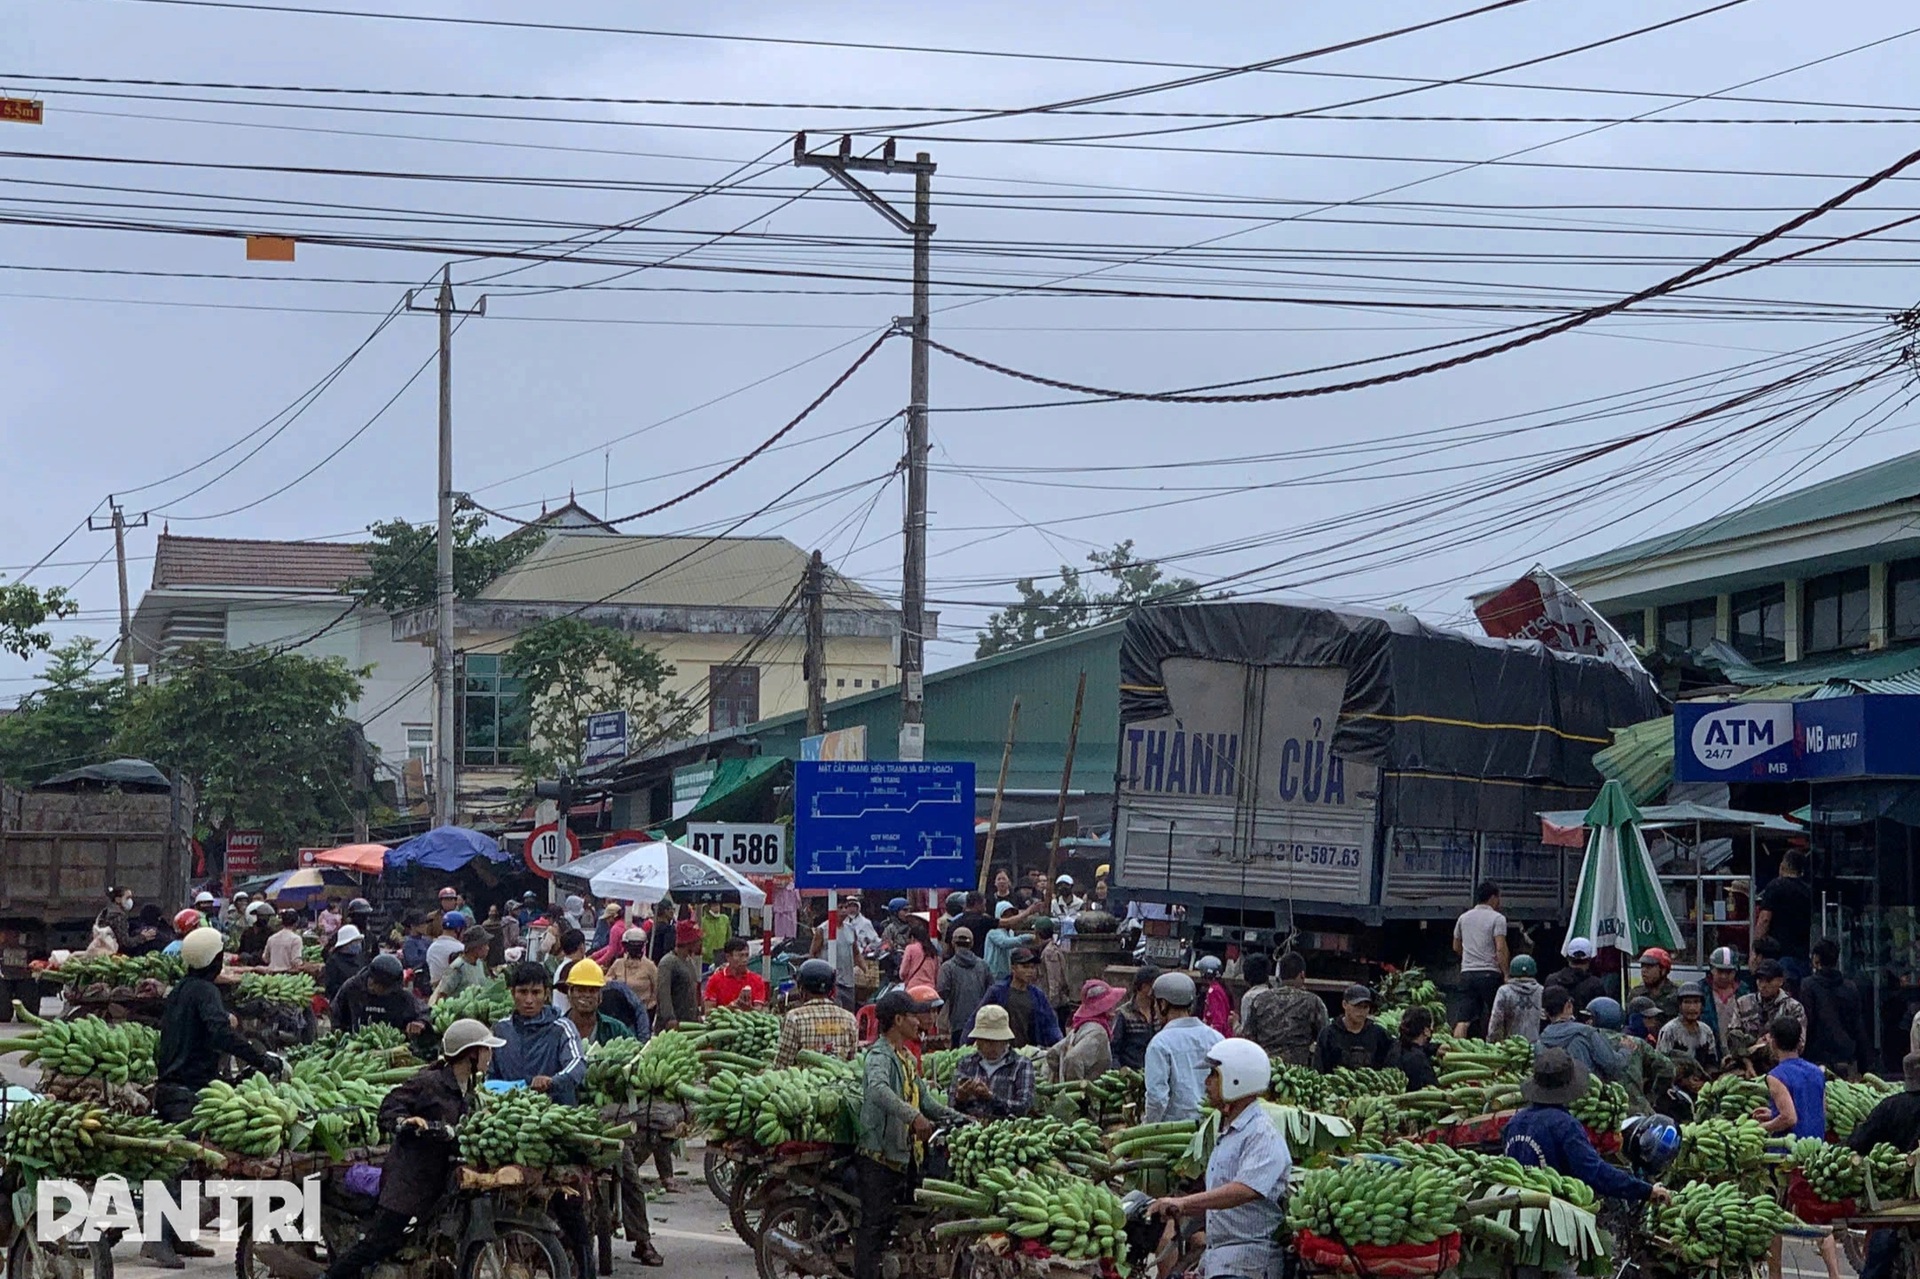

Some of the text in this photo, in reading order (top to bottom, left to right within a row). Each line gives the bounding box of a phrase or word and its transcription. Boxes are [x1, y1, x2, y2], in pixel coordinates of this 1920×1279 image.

[1704, 719, 1773, 745] ATM
[1806, 726, 1858, 753] MB ATM 24/7
[1128, 717, 1346, 804] THÀNH CỦA
[1705, 749, 1733, 760] 24/7
[1768, 762, 1788, 774] MB
[542, 834, 556, 854] 10
